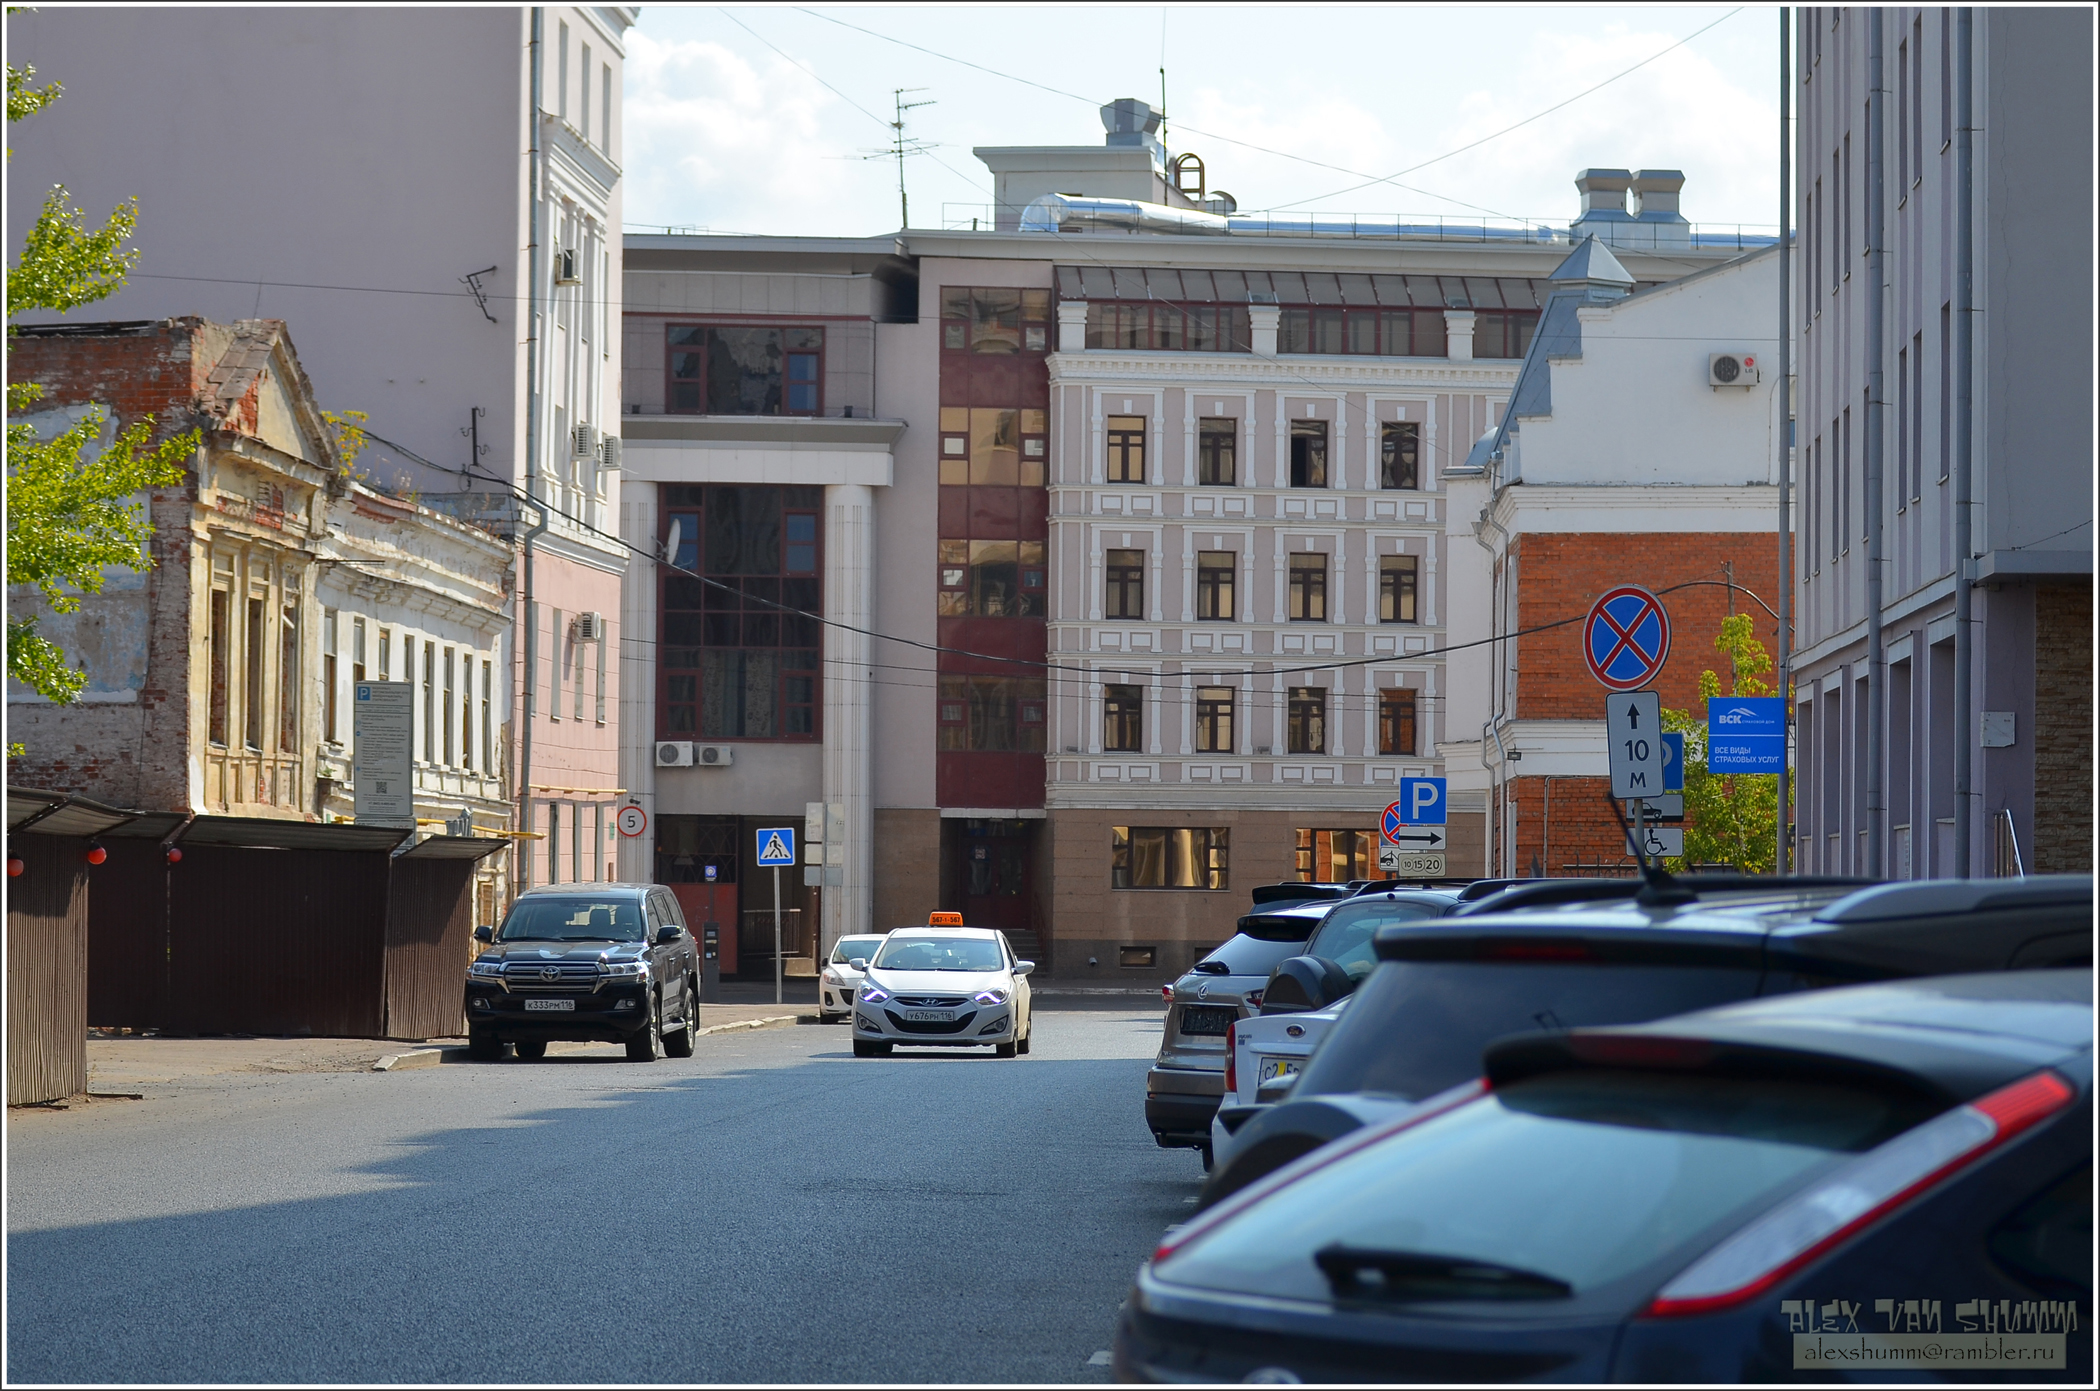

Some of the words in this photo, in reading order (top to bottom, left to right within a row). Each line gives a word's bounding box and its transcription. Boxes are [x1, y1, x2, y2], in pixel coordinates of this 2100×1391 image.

[360, 688, 368, 699] P
[1719, 715, 1742, 724] ВСК
[1624, 739, 1650, 762] 10
[1714, 746, 1729, 754] ВСЕ
[1730, 746, 1751, 755] ВИДЫ
[1412, 782, 1439, 820] P
[627, 815, 636, 828] 5
[1426, 860, 1440, 870] 20
